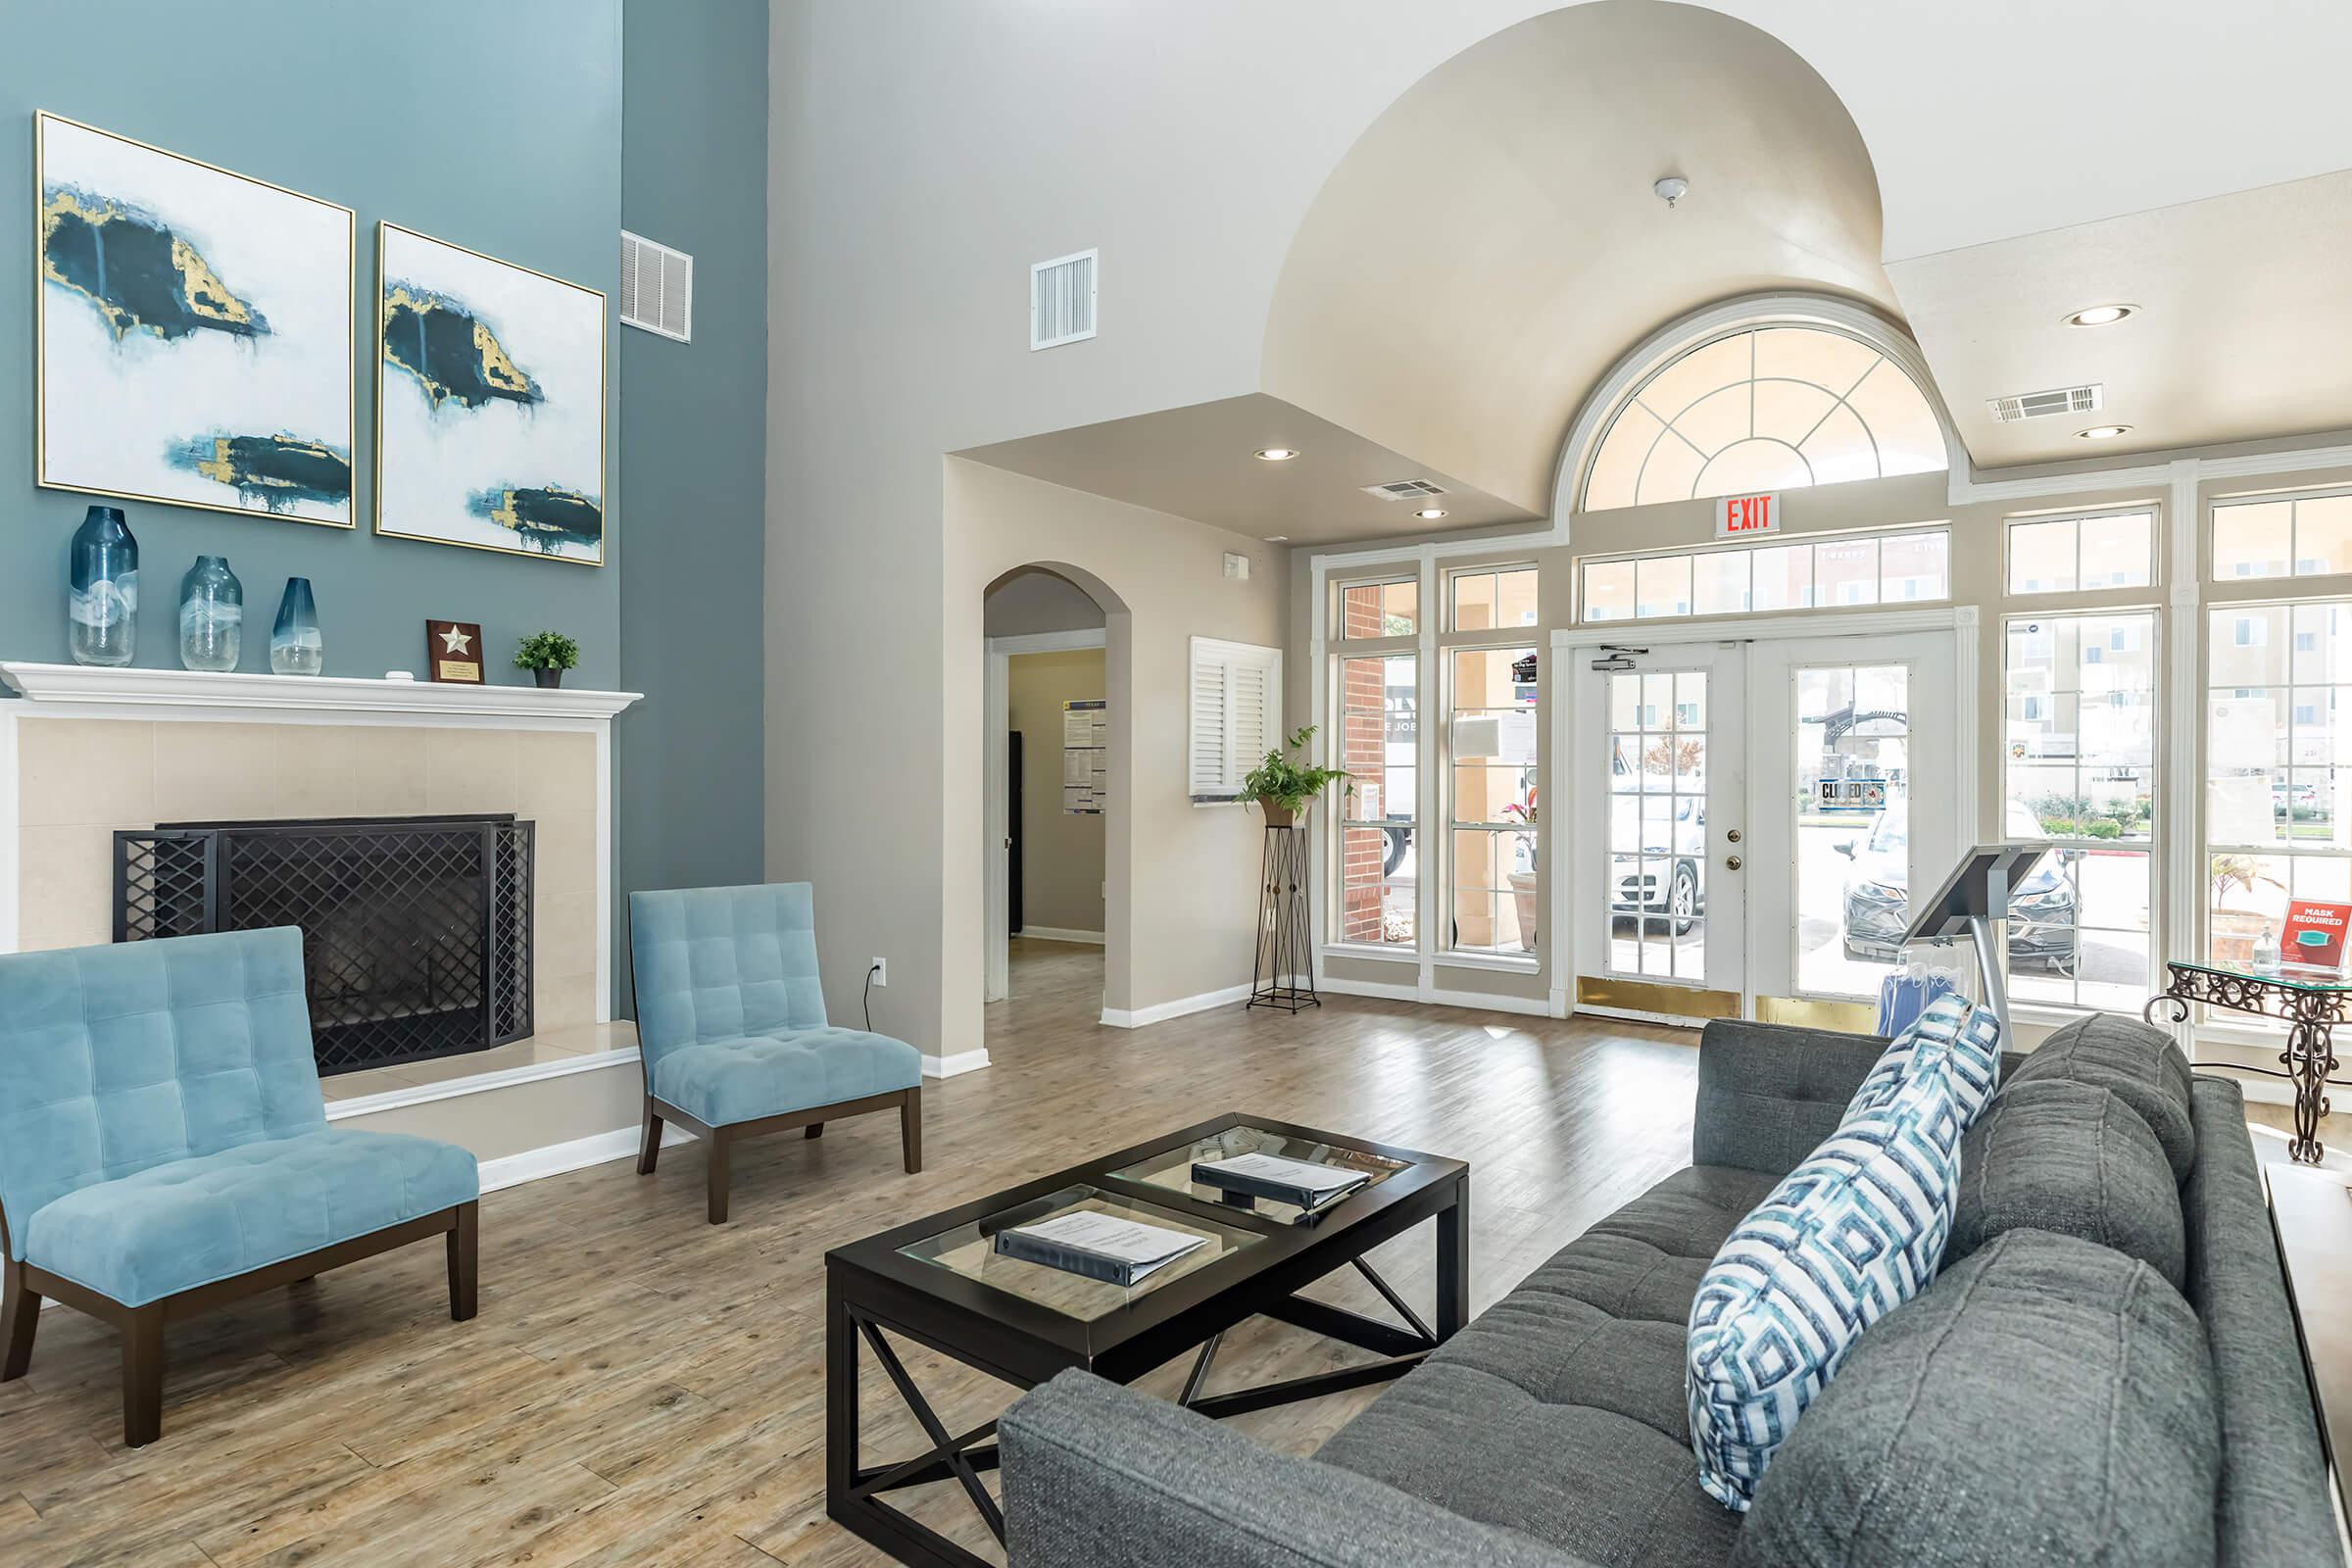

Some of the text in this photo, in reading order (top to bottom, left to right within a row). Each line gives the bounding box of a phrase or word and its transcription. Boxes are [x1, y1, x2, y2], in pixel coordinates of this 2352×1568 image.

[1727, 496, 1771, 531] EXIT
[1822, 783, 1861, 799] CLED
[2304, 907, 2334, 917] MASK
[2292, 914, 2342, 926] REQUIRED
